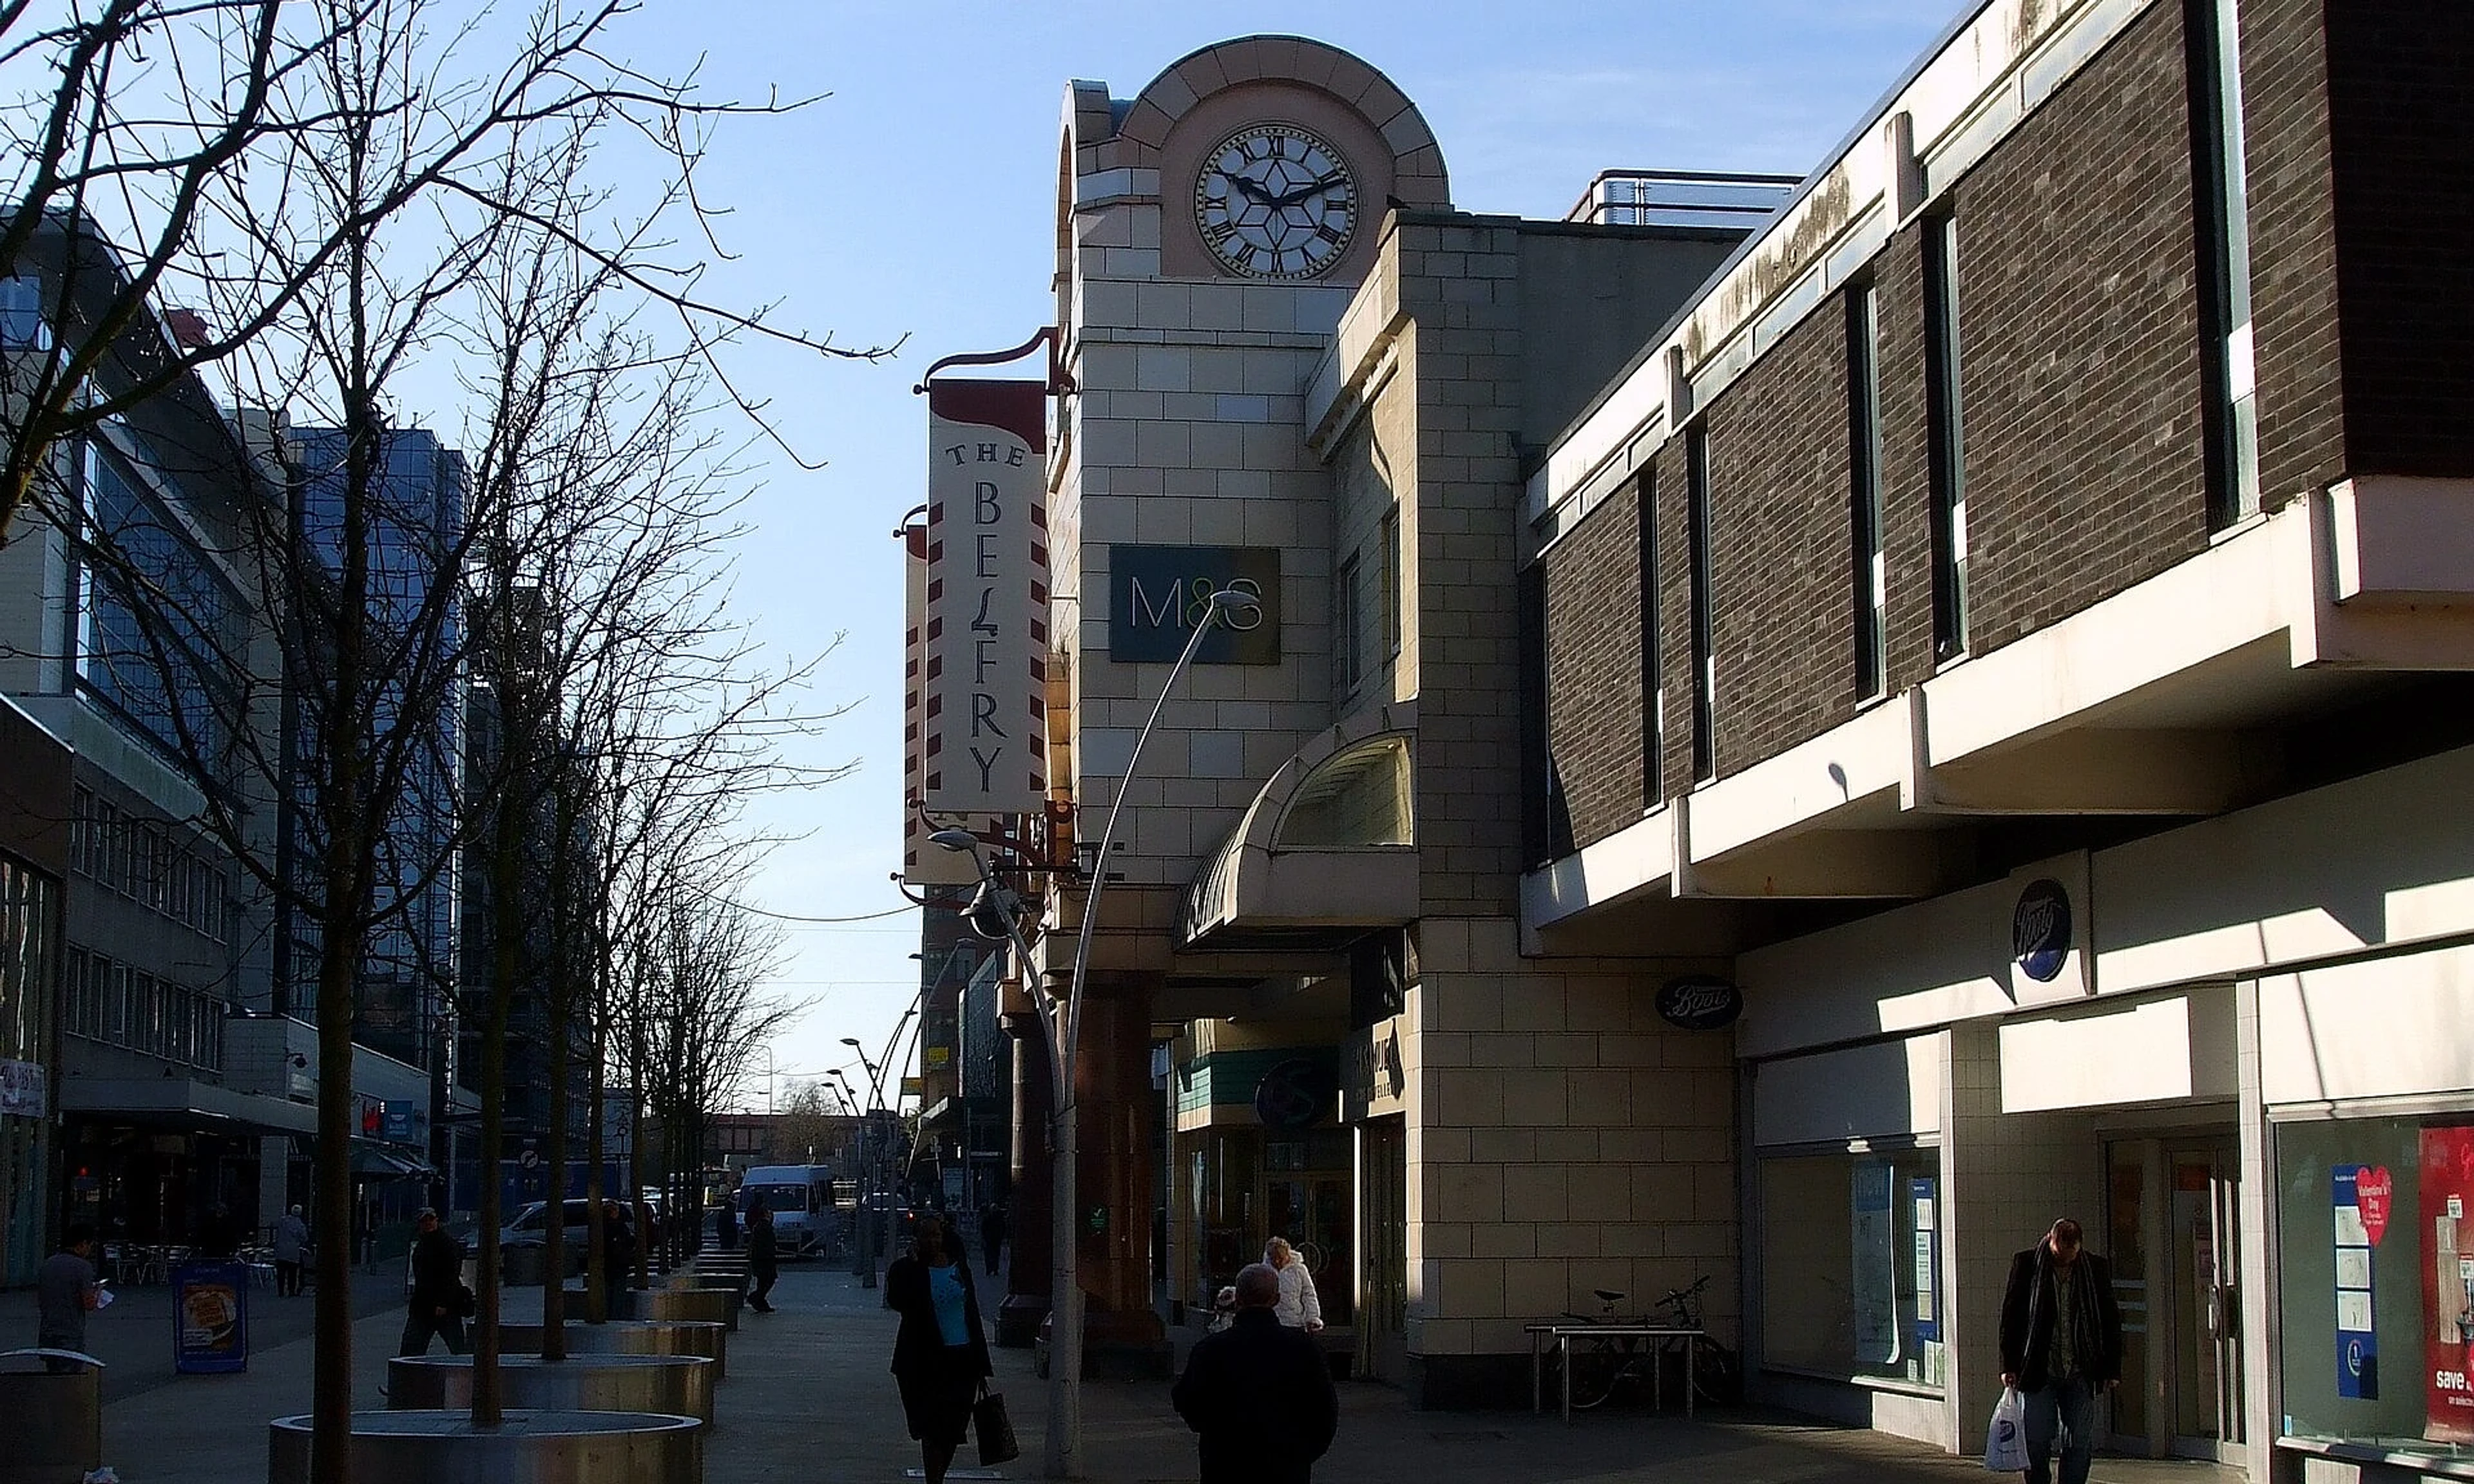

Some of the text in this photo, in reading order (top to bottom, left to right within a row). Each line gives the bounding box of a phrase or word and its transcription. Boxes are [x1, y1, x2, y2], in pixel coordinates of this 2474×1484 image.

[1234, 143, 1257, 164] XI
[1268, 136, 1285, 157] XII
[1299, 146, 1312, 164] I
[1205, 196, 1227, 210] IX
[1326, 200, 1348, 211] III
[1211, 222, 1236, 245] VIII
[1234, 243, 1257, 269] VII
[1271, 251, 1284, 272] VI
[1301, 245, 1316, 265] V
[945, 442, 1026, 468] THE
[1131, 576, 1263, 631] M&S
[970, 481, 1008, 792] BELFRY
[2017, 897, 2055, 962] Boots
[1666, 984, 1732, 1018] Boots
[2368, 1198, 2380, 1212] Day
[2436, 1370, 2465, 1390] save
